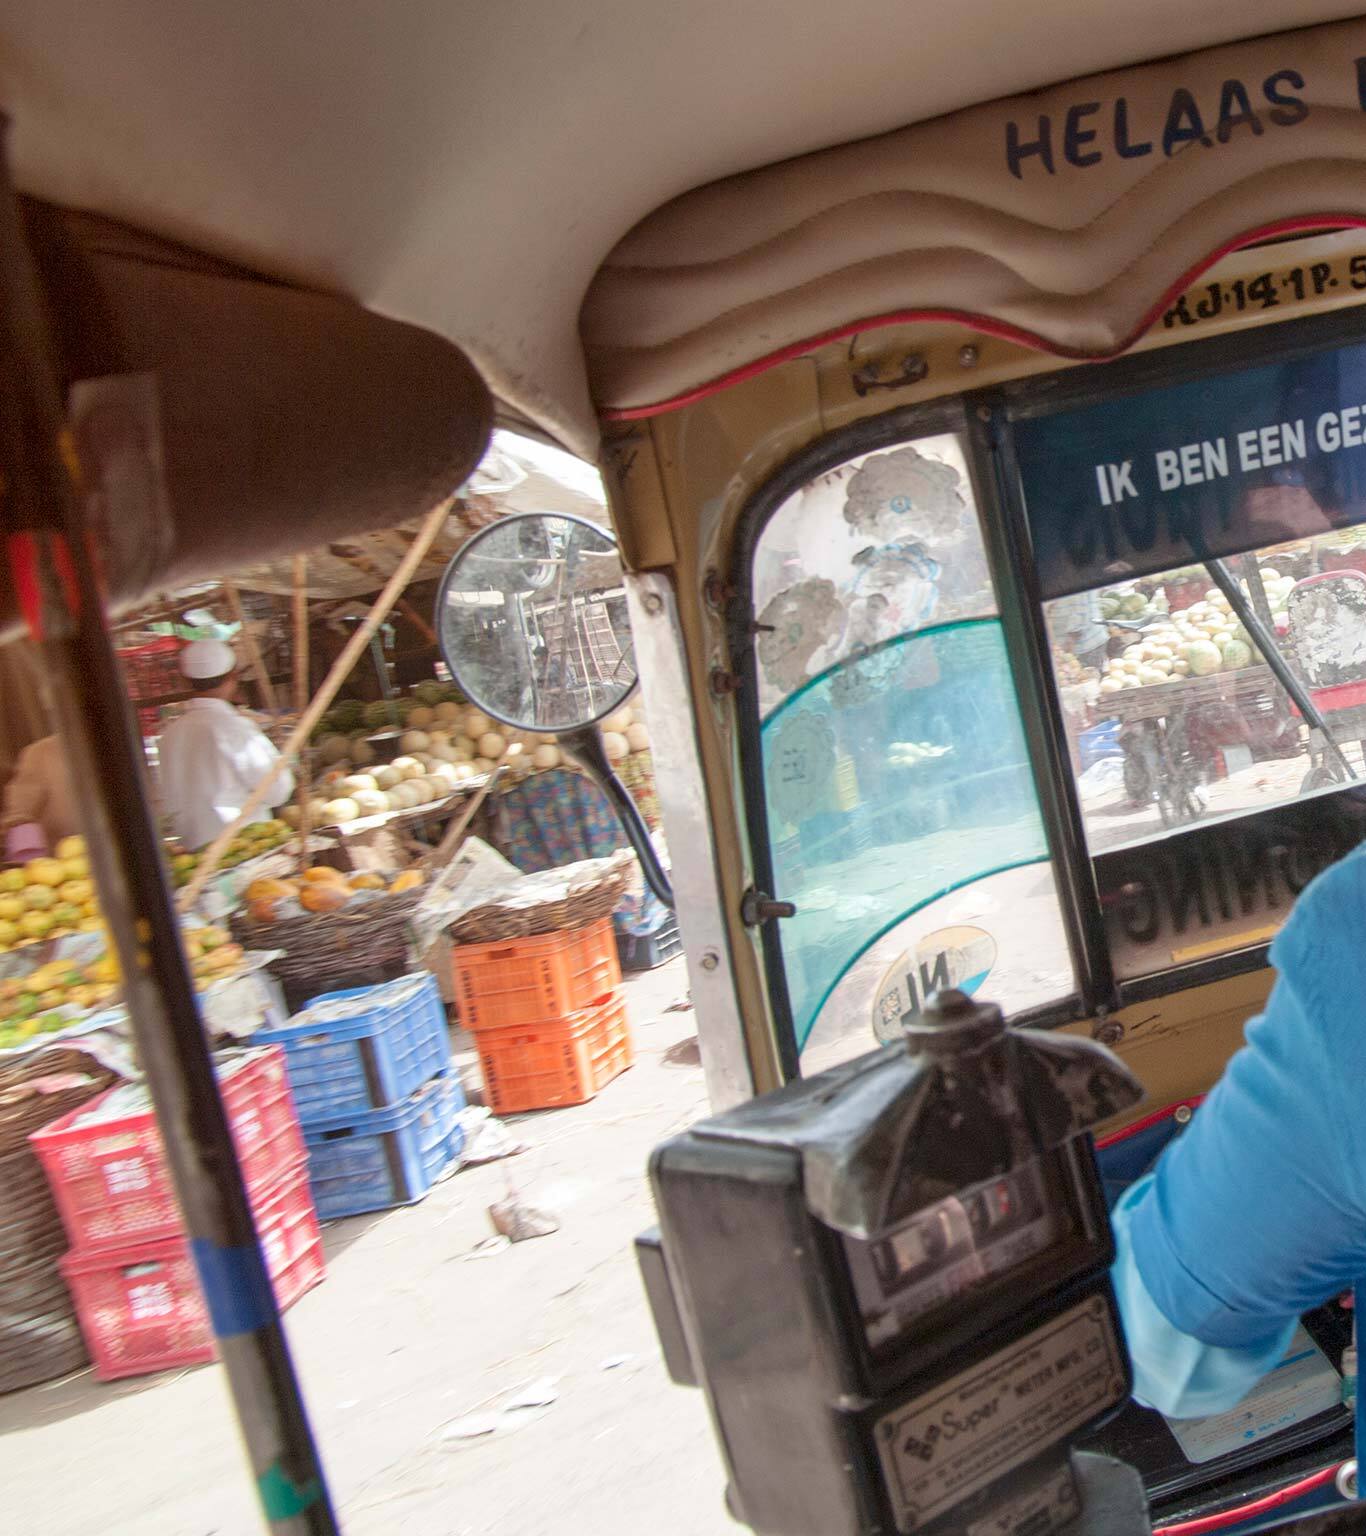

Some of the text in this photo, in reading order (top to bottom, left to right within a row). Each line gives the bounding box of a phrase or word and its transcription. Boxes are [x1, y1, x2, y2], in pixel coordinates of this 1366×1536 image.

[1004, 69, 1310, 180] HELAAS
[1095, 460, 1139, 506] IK
[1155, 437, 1229, 491] BEN
[1237, 419, 1306, 472] EEN
